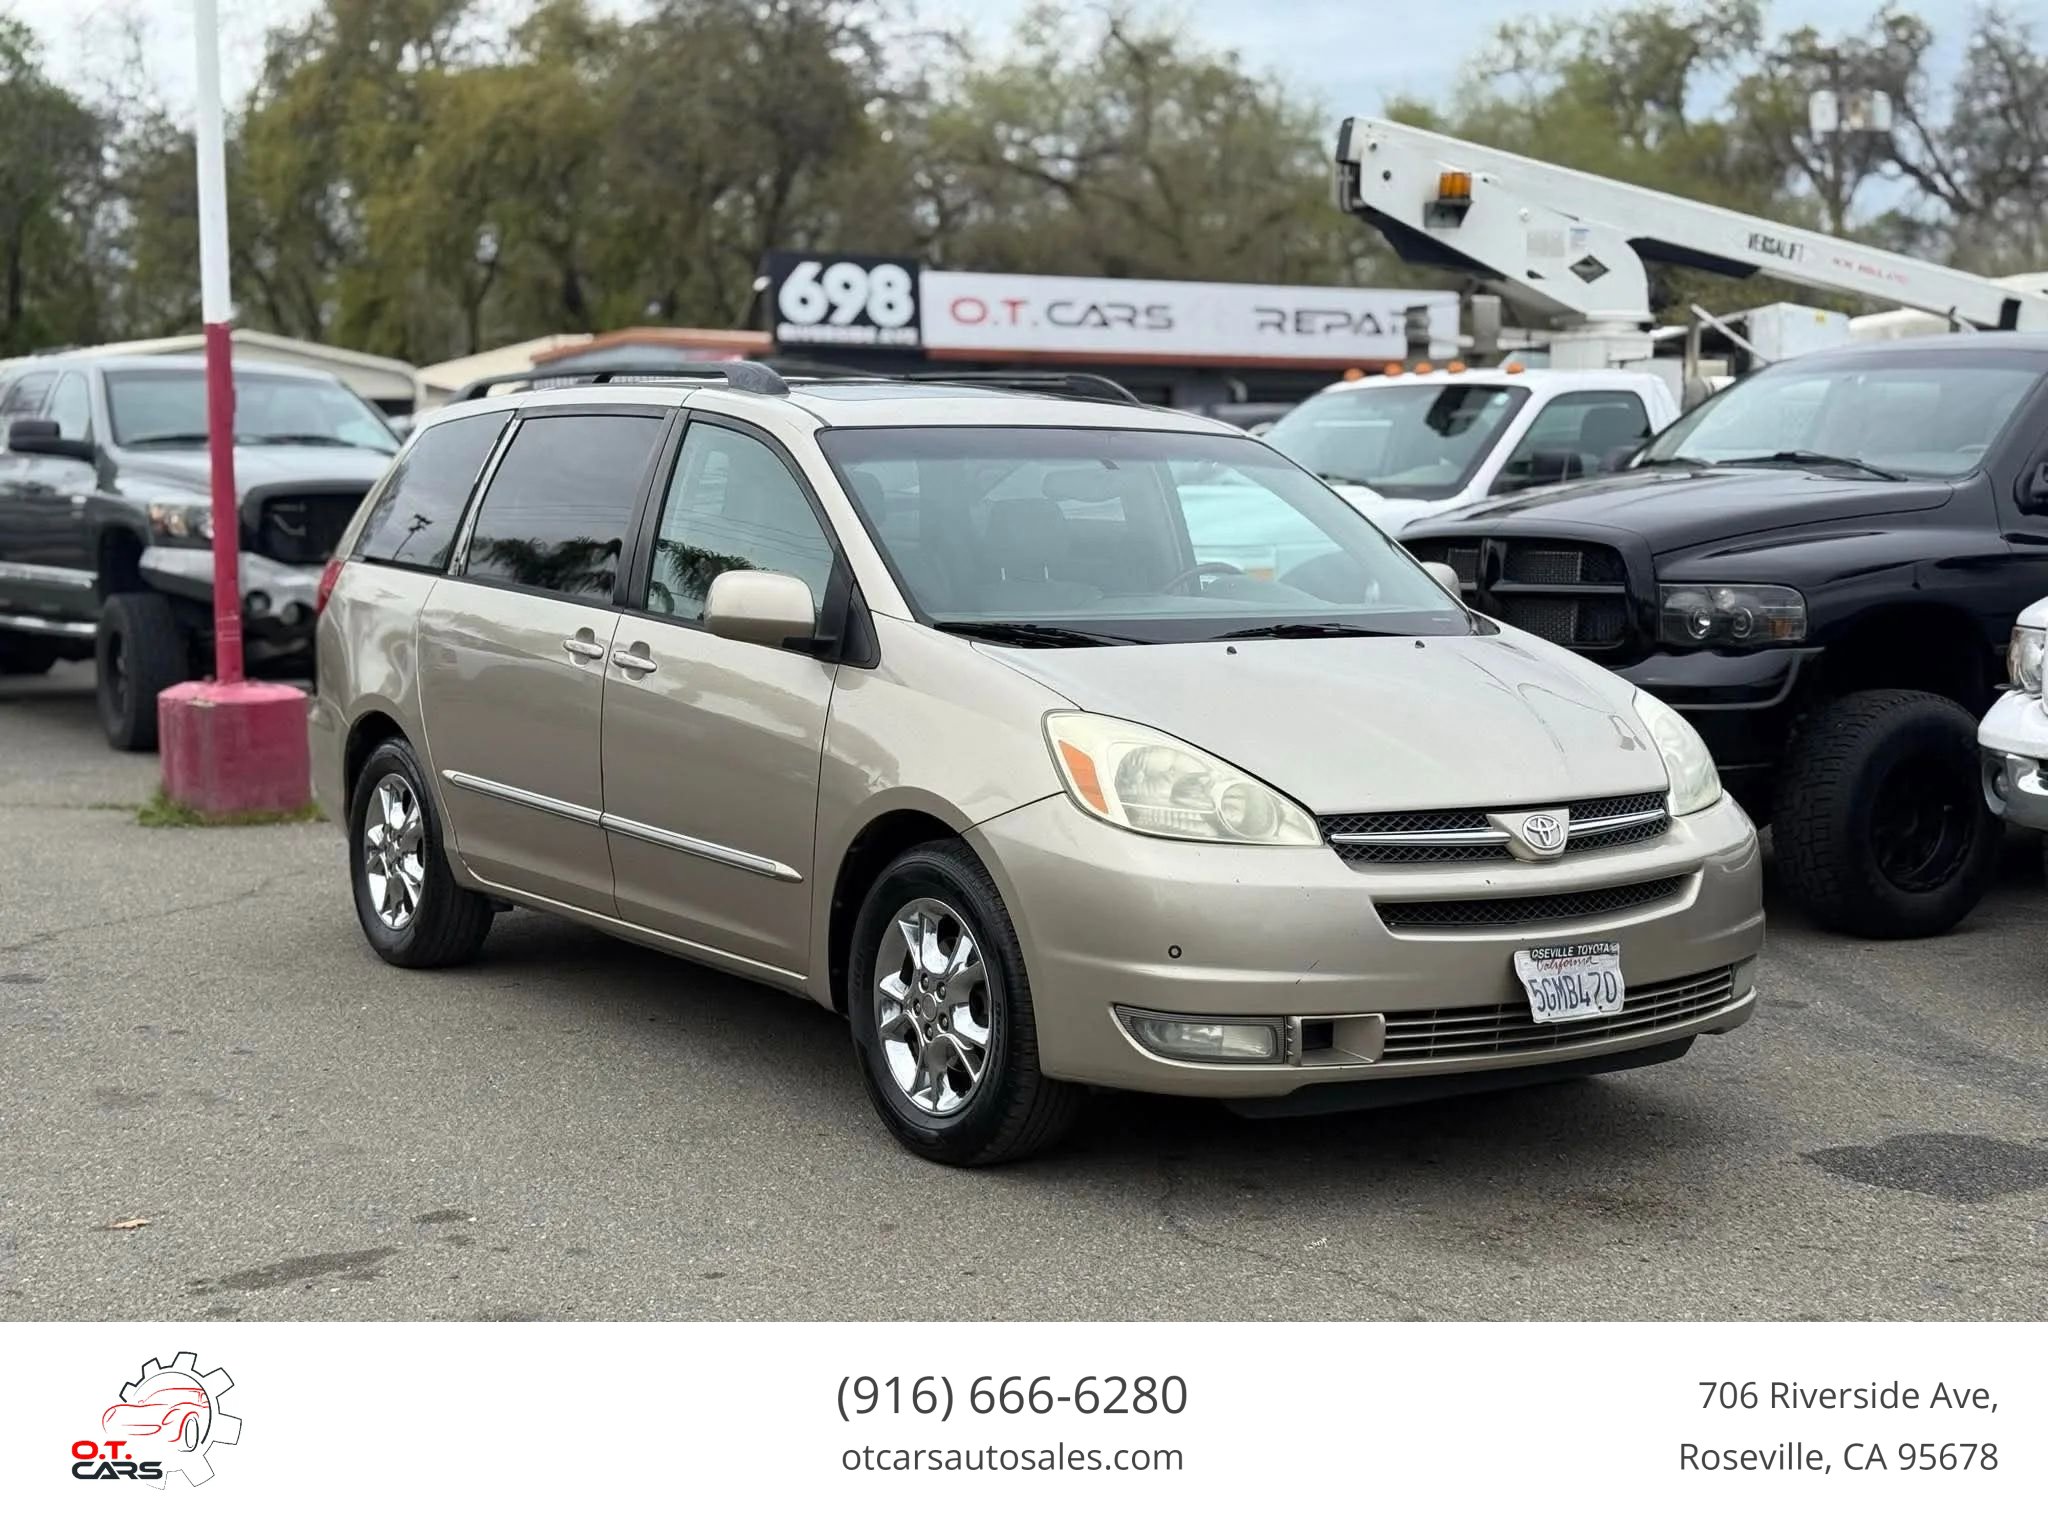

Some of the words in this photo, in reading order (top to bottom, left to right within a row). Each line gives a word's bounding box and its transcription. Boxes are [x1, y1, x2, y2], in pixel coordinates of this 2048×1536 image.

[778, 261, 915, 328] 698
[1046, 302, 1175, 330] CARS
[1577, 943, 1609, 955] TOYOTA
[1528, 971, 1617, 1012] 5GMB470
